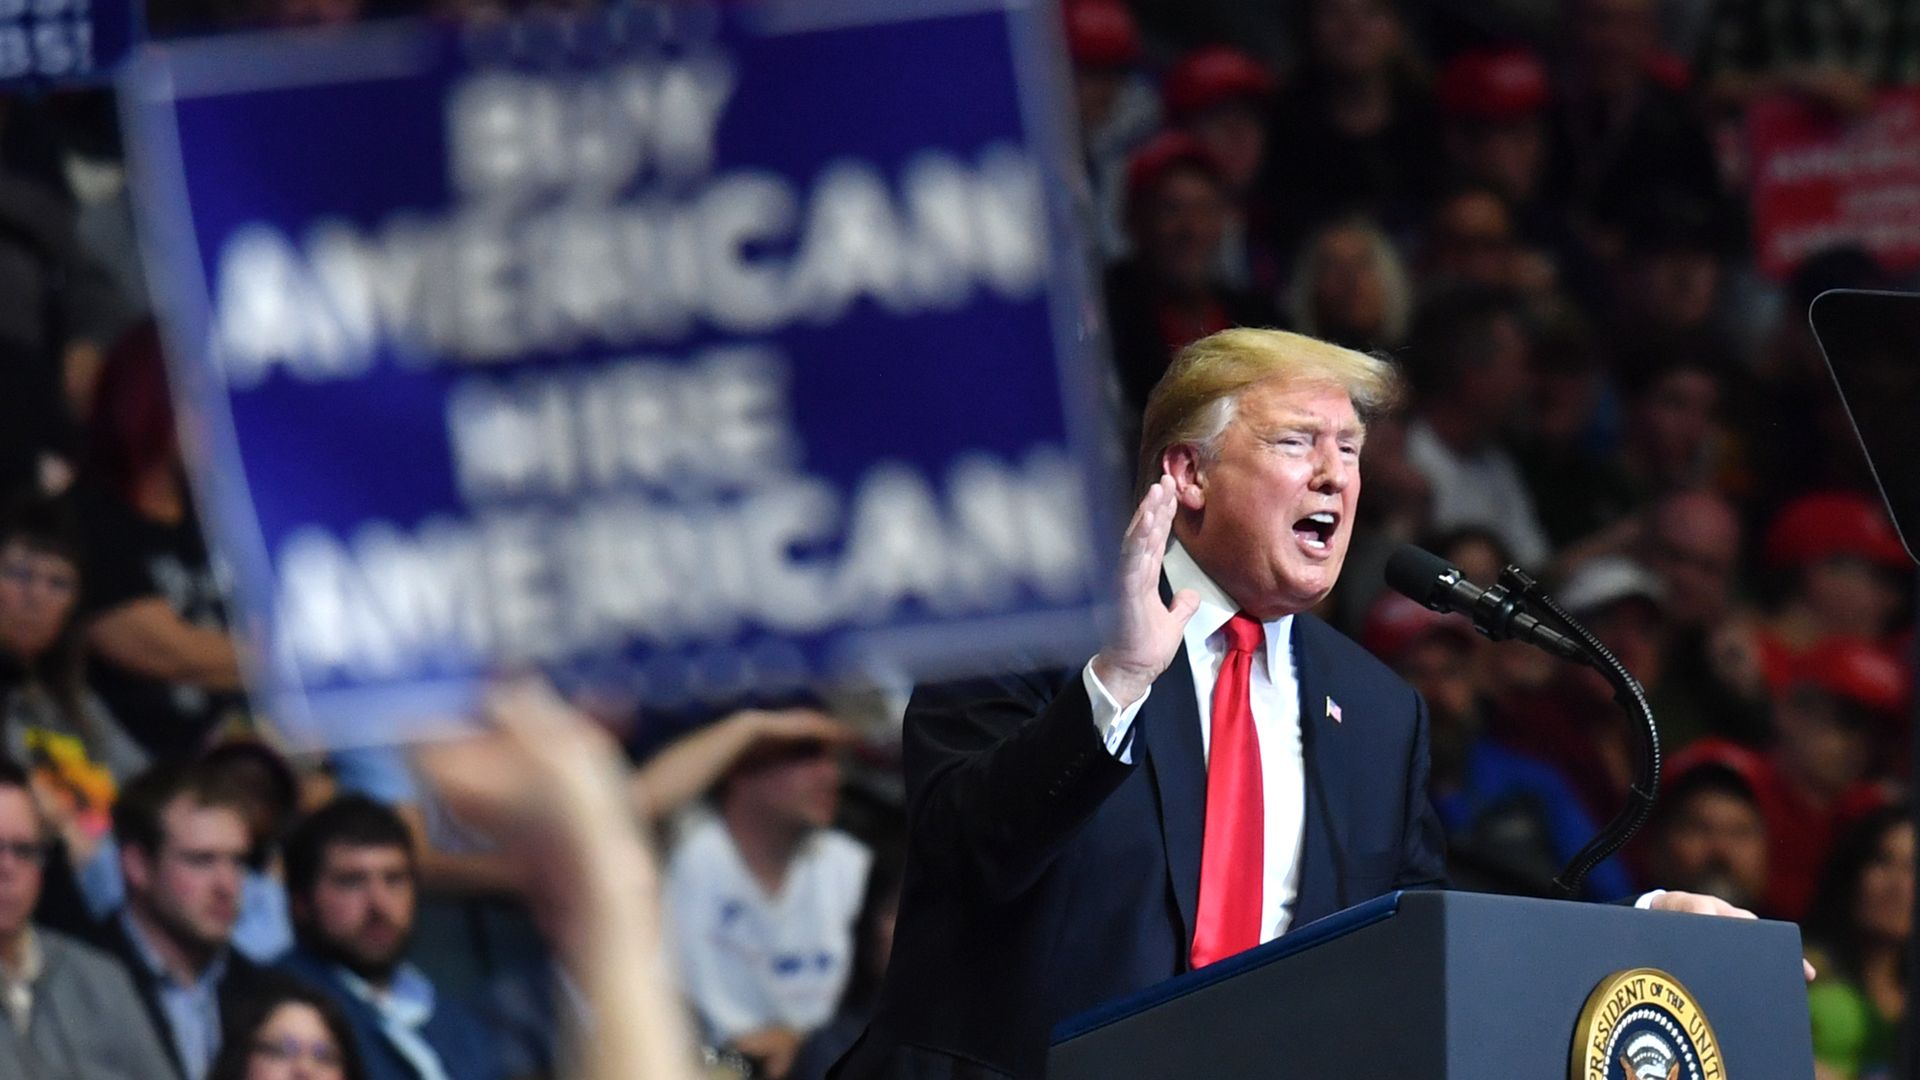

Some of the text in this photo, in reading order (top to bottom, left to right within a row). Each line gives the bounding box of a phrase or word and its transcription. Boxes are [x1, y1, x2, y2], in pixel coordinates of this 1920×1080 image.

[445, 64, 733, 198] BUY
[214, 145, 1046, 386] AMERICAN
[448, 350, 786, 500] HIRE
[276, 452, 1086, 680] AMERICAN
[1589, 978, 1646, 1080] PRESIDENT
[1650, 982, 1663, 997] OF
[1666, 988, 1685, 1014] THE
